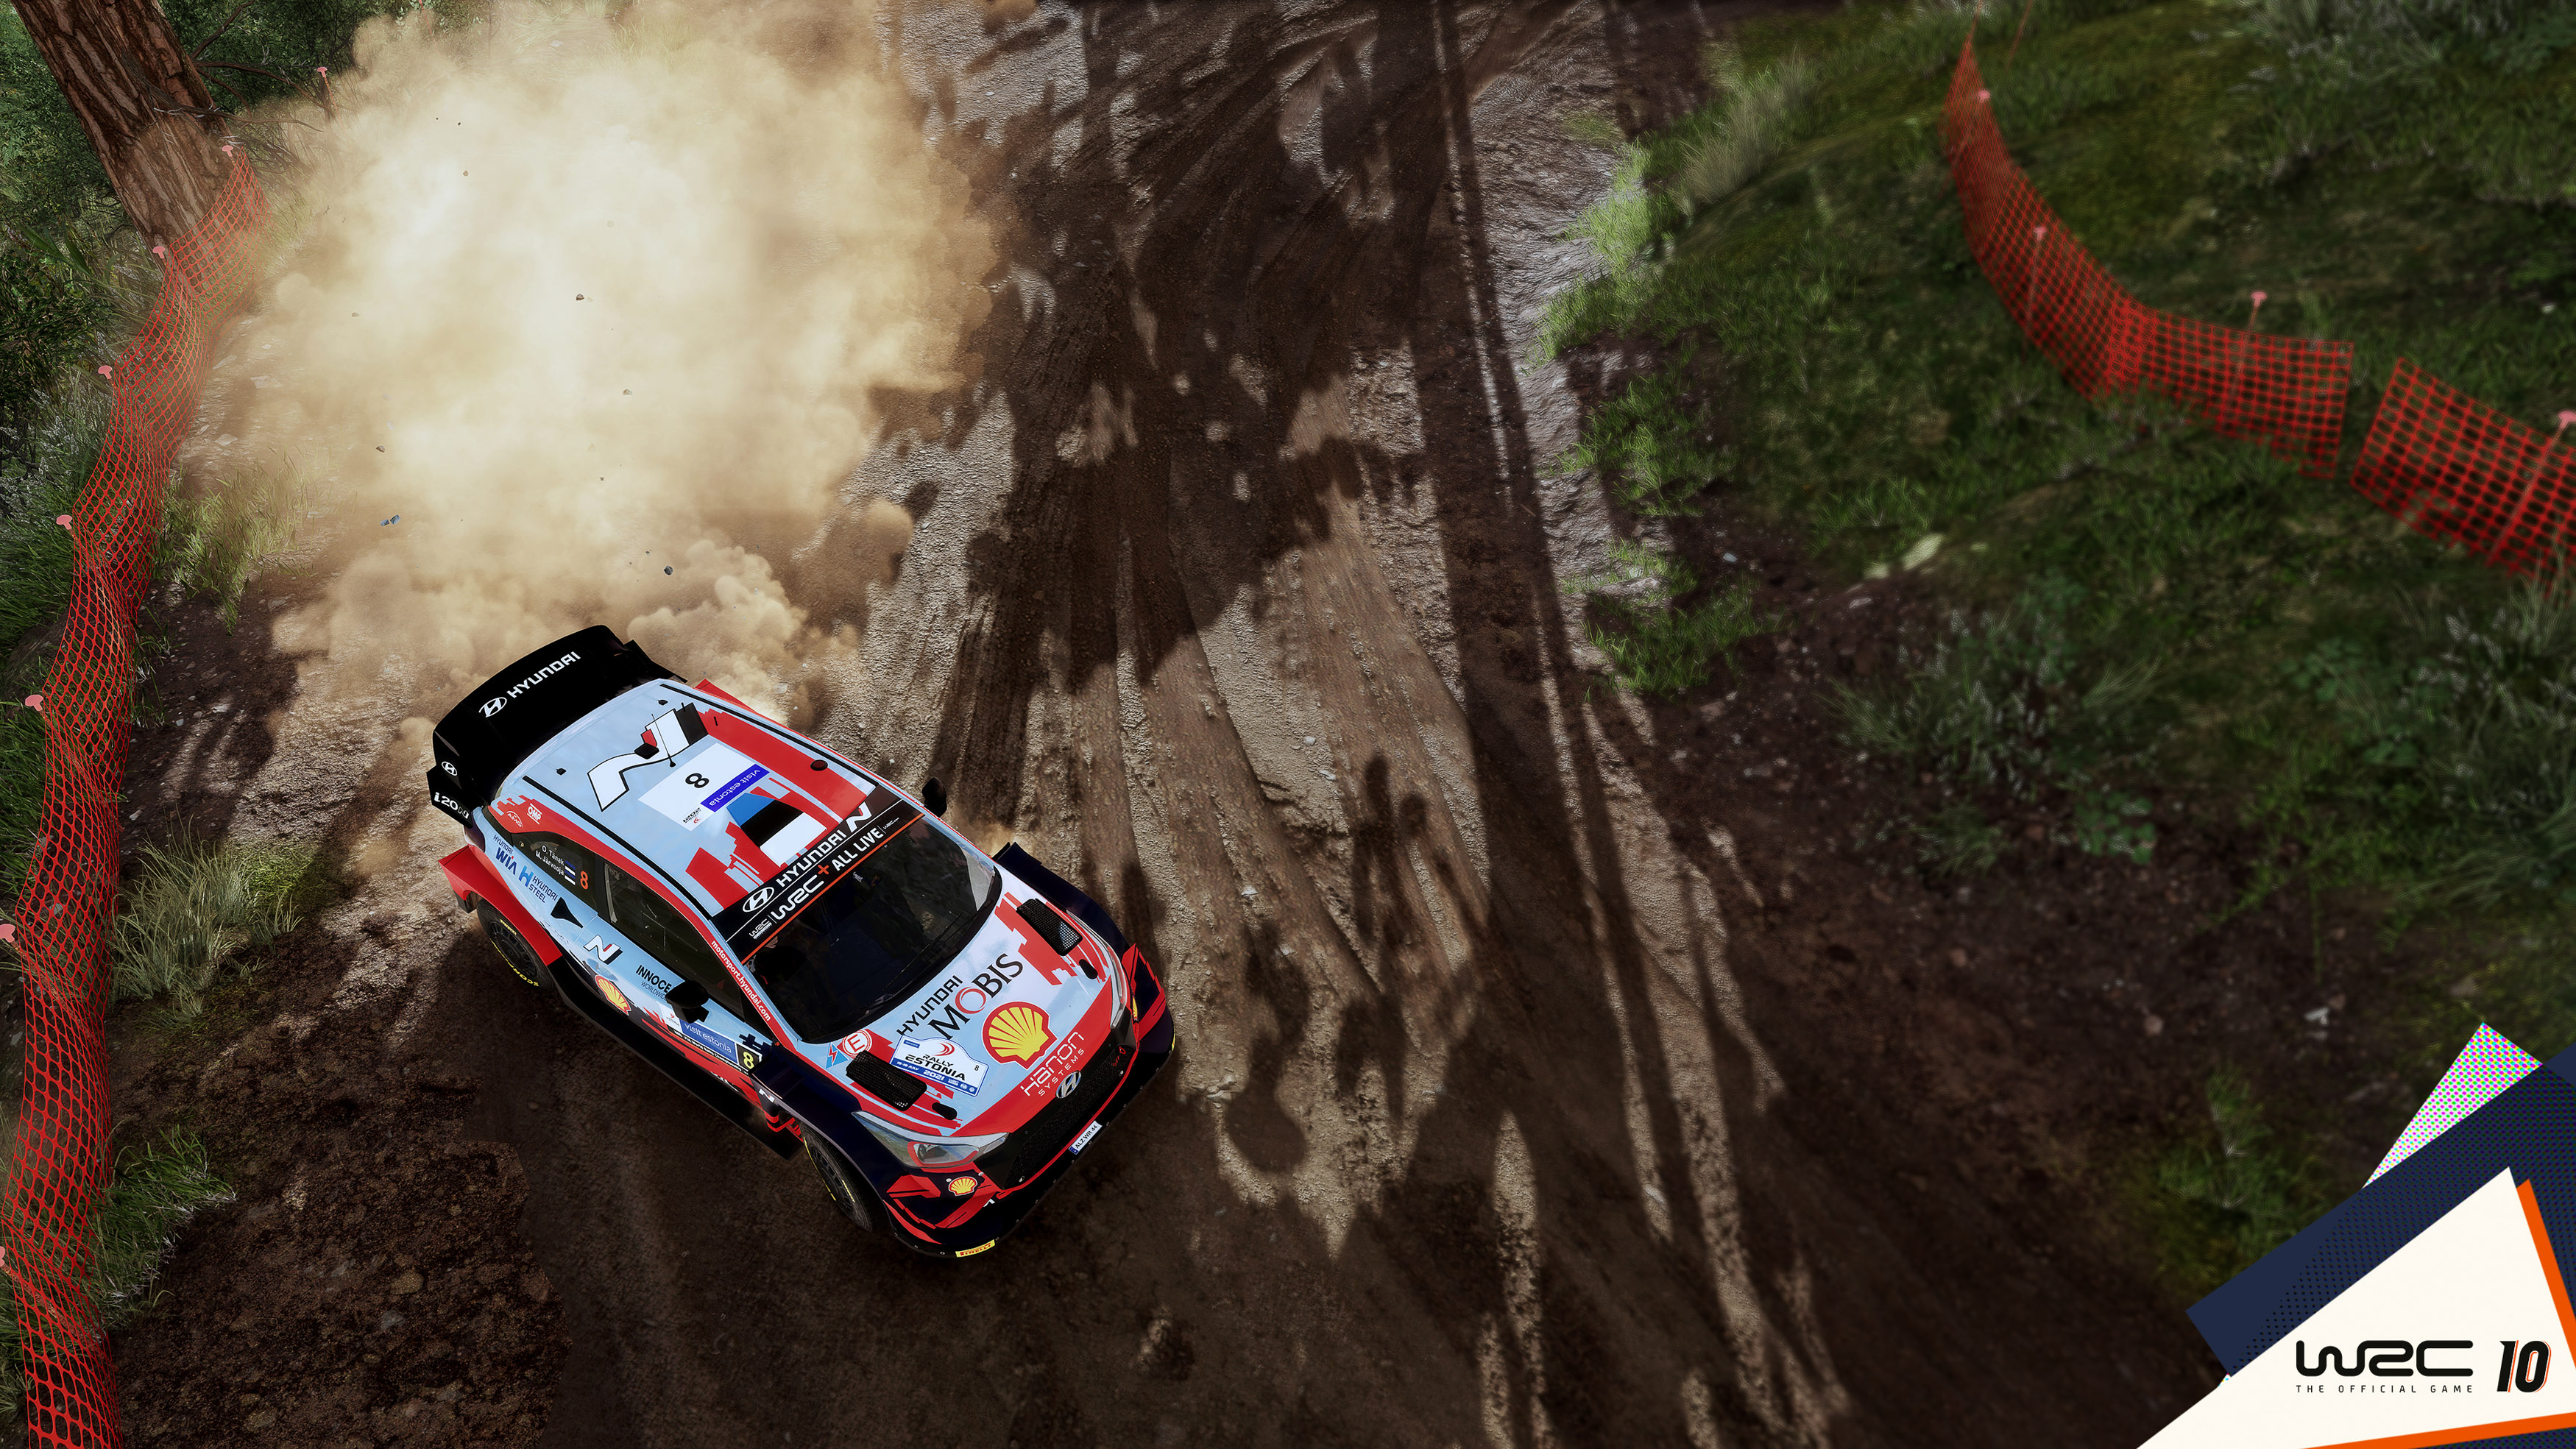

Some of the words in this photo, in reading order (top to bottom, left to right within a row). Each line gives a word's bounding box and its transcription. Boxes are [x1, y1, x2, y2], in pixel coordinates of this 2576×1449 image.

[506, 651, 581, 698] HYUNDAI
[684, 773, 710, 789] 8
[742, 769, 760, 784] visit
[709, 782, 741, 807] estonia
[527, 805, 542, 822] OMP
[493, 835, 514, 854] HYUNDAI
[831, 849, 858, 871] ALL
[853, 827, 884, 852] LIVE
[495, 847, 517, 875] WIA
[775, 829, 847, 888] HYUNDAI
[528, 883, 546, 903] STEEL
[532, 876, 559, 901] HYUNDAI
[580, 871, 589, 890] 8
[635, 965, 673, 993] INNOCE
[641, 980, 668, 1001] WORLDWID
[711, 940, 771, 1021] motorsport.hyundai.com
[896, 975, 963, 1035] HYUNDAI
[927, 953, 1023, 1040] MOBIS
[684, 1022, 703, 1037] visit
[702, 1032, 732, 1054] estonia
[743, 1052, 755, 1069] 8
[905, 1054, 966, 1081] ESTONIA
[922, 1054, 954, 1067] RALLY
[1038, 1048, 1085, 1097] SYSTEMS
[923, 1069, 945, 1081] 2021
[1075, 1138, 1086, 1149] ALZ
